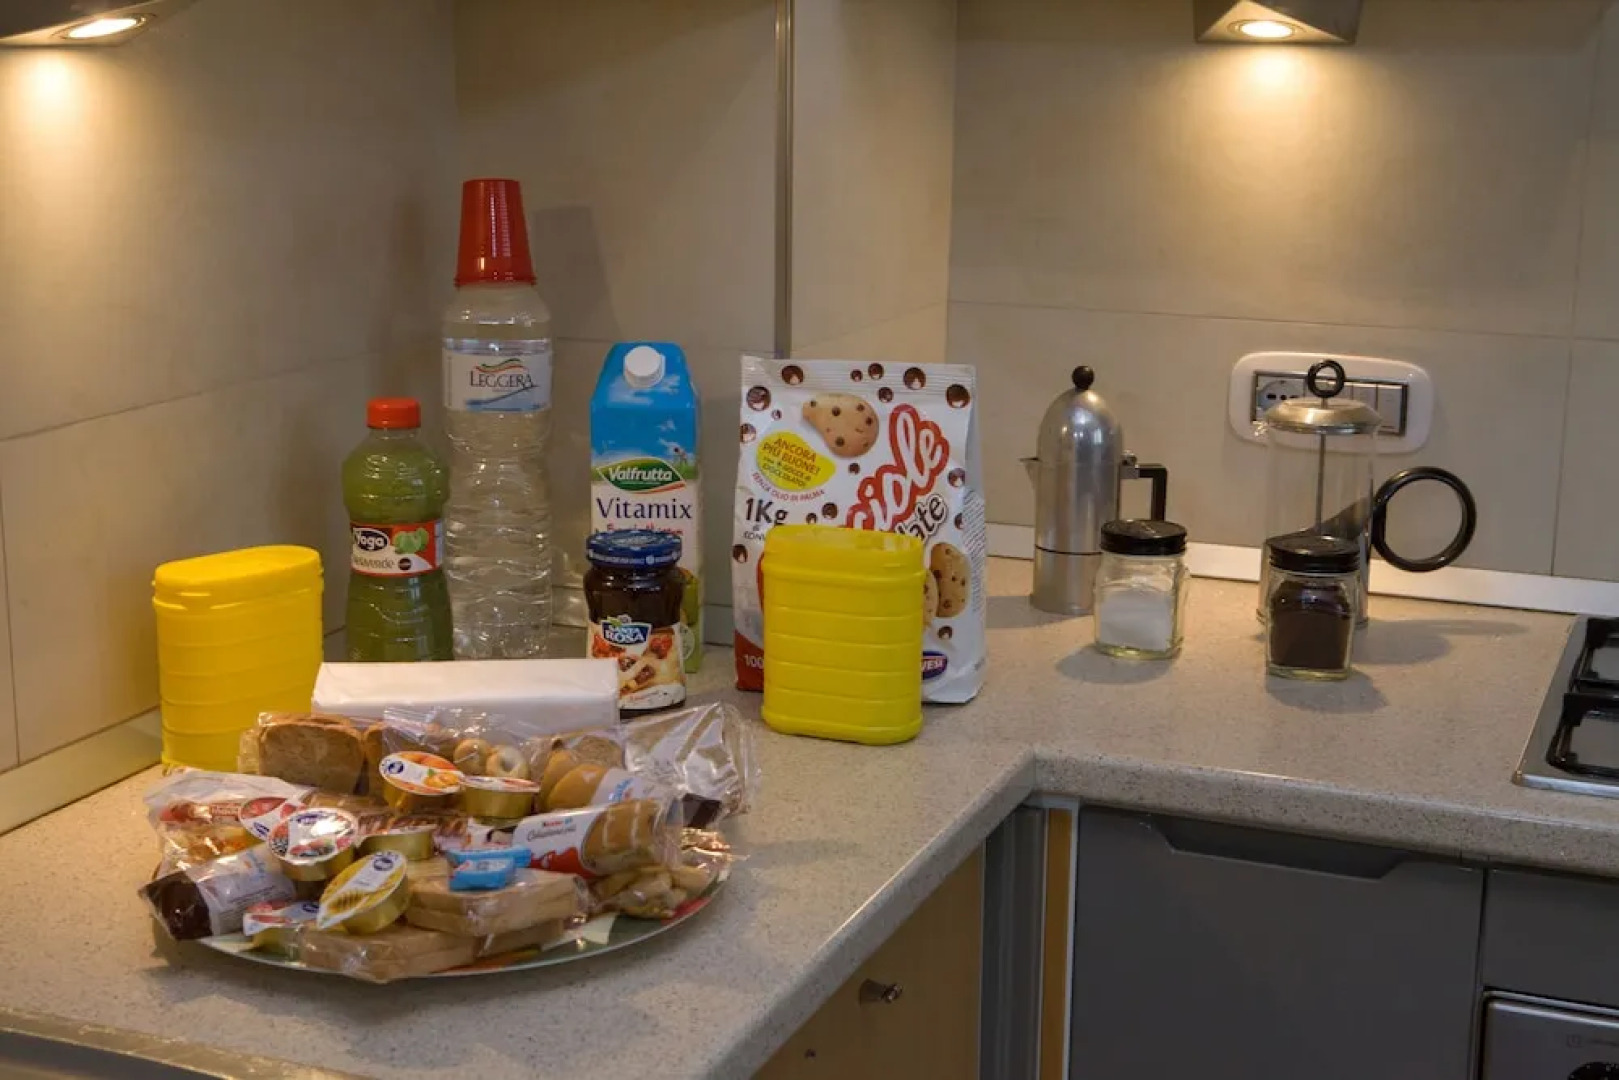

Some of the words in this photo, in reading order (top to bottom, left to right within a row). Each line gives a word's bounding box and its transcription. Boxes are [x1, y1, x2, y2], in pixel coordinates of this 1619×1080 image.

[469, 370, 534, 388] LEGGERA
[773, 438, 816, 463] ANCORA
[608, 466, 673, 482] Valfrutta
[595, 497, 692, 519] Vitamix
[745, 498, 788, 527] 1Kg
[353, 528, 386, 550] Yoga
[604, 628, 645, 644] ROSA
